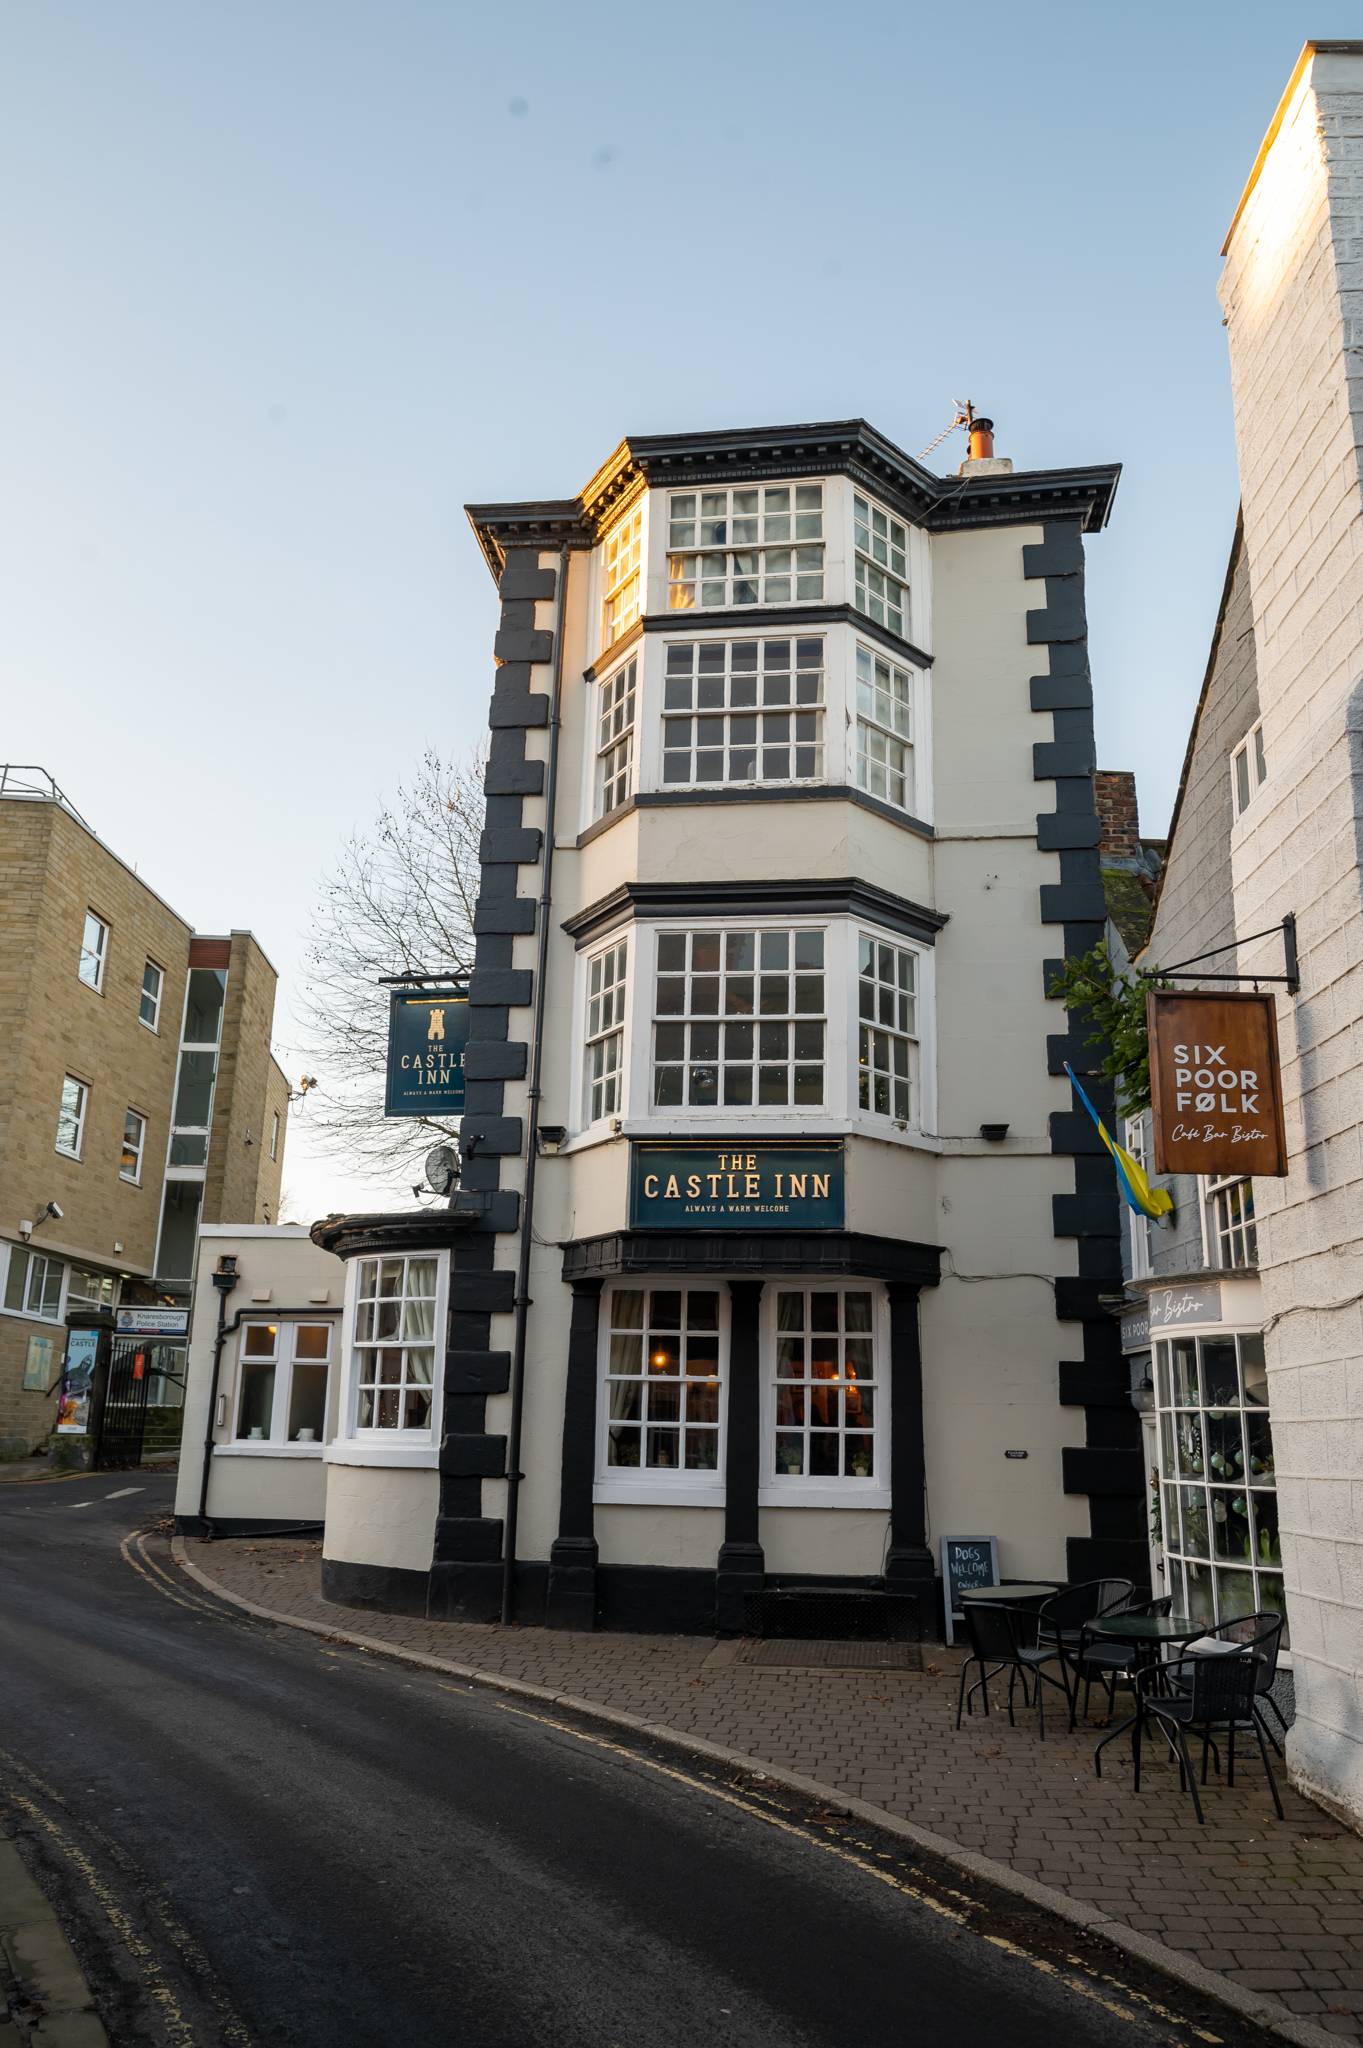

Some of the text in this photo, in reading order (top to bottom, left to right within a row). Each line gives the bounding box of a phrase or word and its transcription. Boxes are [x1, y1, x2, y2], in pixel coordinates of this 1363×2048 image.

[427, 1045, 444, 1053] THE
[1173, 1044, 1227, 1065] SIX
[417, 1069, 450, 1085] INN
[1175, 1068, 1259, 1090] POOR
[1176, 1092, 1260, 1114] FØLK
[1203, 1124, 1228, 1142] Bar
[1231, 1125, 1269, 1143] Bistro
[718, 1154, 757, 1171] THE
[644, 1174, 831, 1198] CASTLE INN
[684, 1205, 790, 1213] ALWAYS A WARM WELCOME
[1162, 1290, 1204, 1323] Bistro
[1122, 1321, 1149, 1339] SIX POOR
[955, 1546, 980, 1561] DOGS
[950, 1561, 989, 1577] WELCOME
